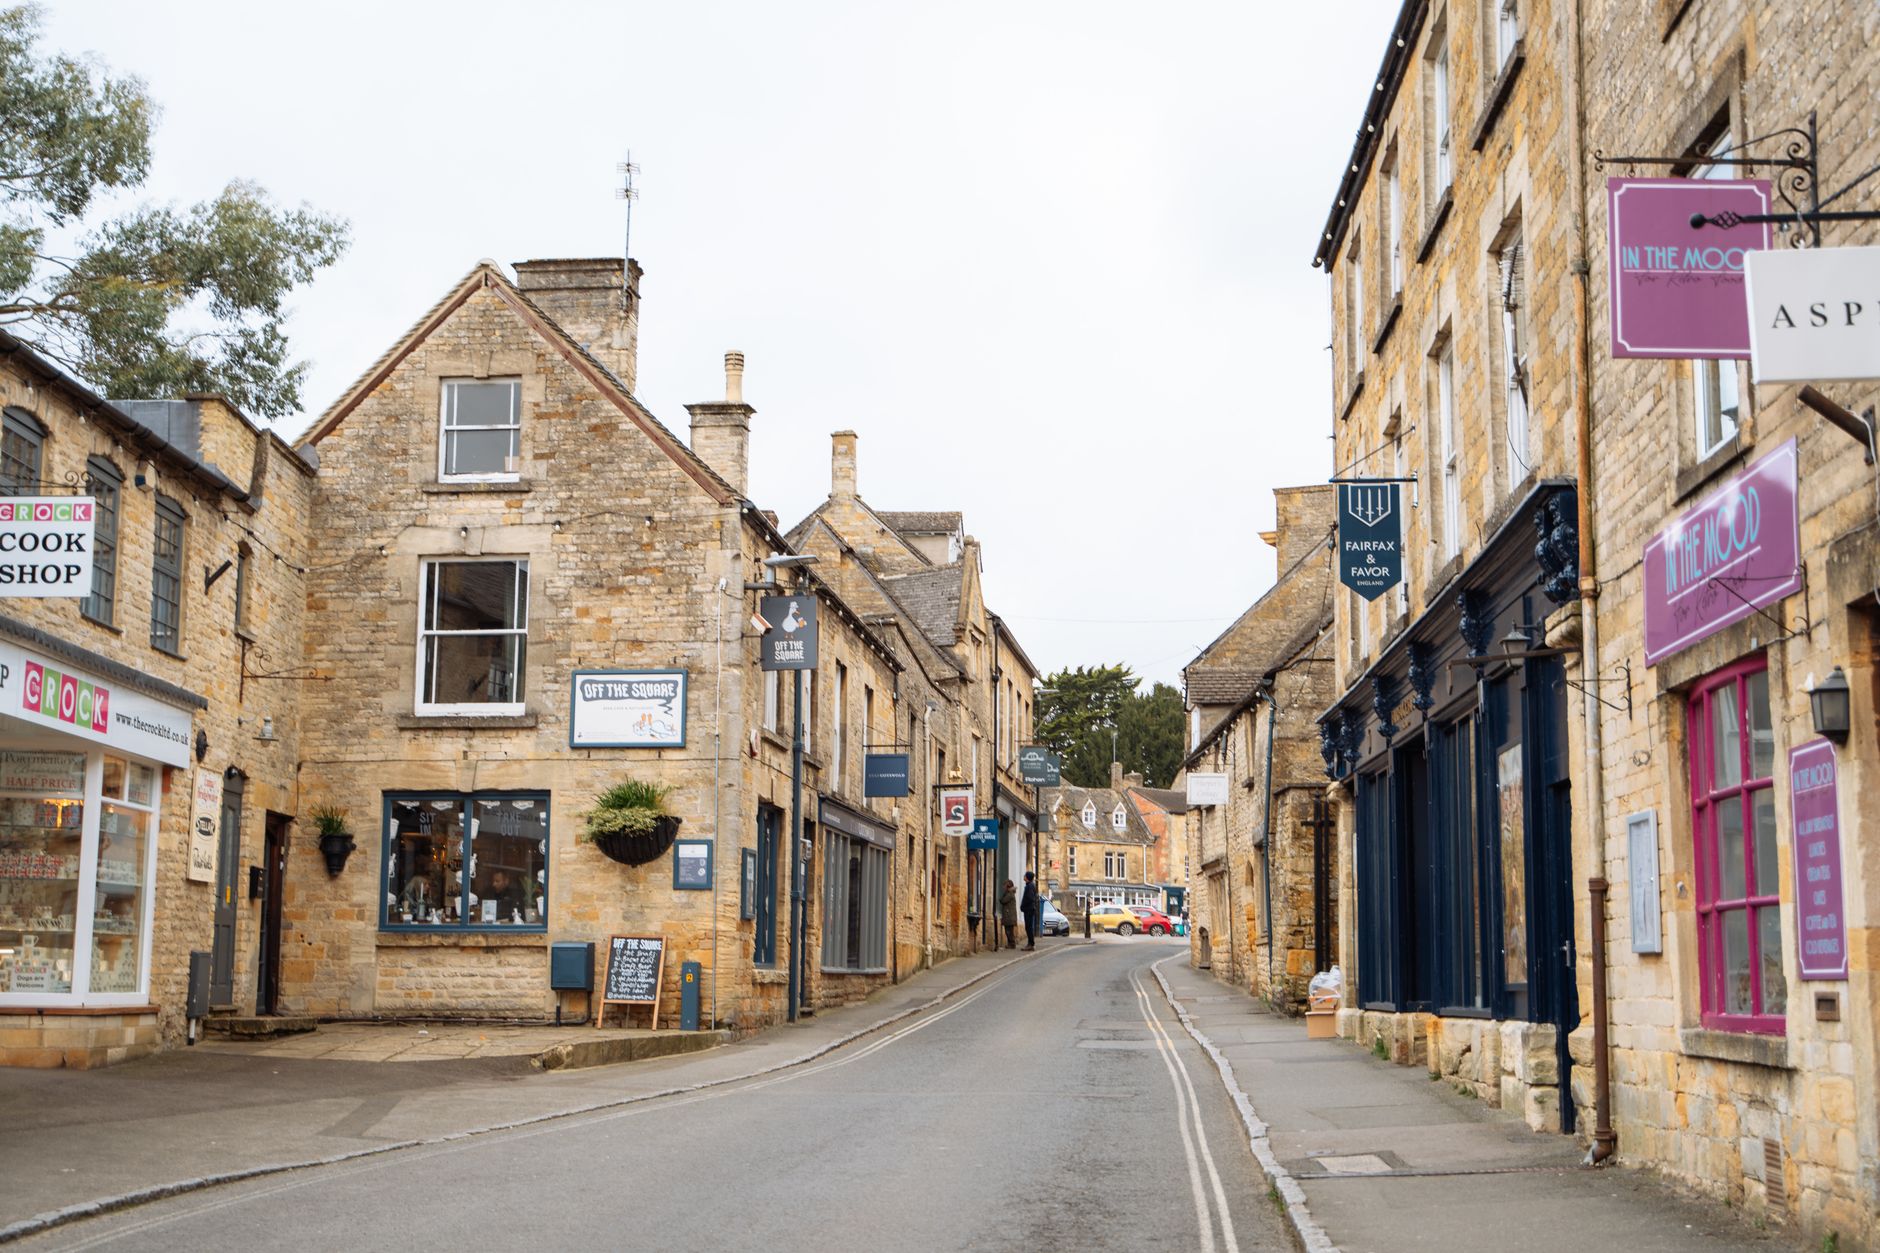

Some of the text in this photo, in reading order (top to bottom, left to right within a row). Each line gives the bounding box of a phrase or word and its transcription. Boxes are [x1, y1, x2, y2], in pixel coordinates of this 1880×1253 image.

[1622, 246, 1756, 270] IN THE MOO
[1771, 300, 1880, 328] ASP
[0, 505, 86, 520] CROCK
[0, 532, 86, 552] COOK
[1680, 523, 1702, 586] THE
[1704, 487, 1760, 573] MOOD
[1346, 541, 1395, 551] FAIRFAX
[1366, 554, 1375, 564] &
[0, 564, 82, 584] SHOP
[1351, 567, 1390, 577] FAVOR
[774, 640, 804, 651] OFF THE
[774, 651, 804, 661] SQUARE
[26, 670, 104, 724] CROCK
[584, 683, 675, 698] OFF THE SQUARE
[6, 776, 77, 789] HALF PRICE
[420, 812, 436, 823] SIT
[497, 812, 520, 824] TAKE
[420, 824, 431, 836] IN
[501, 824, 520, 837] OUT
[626, 939, 639, 949] THE
